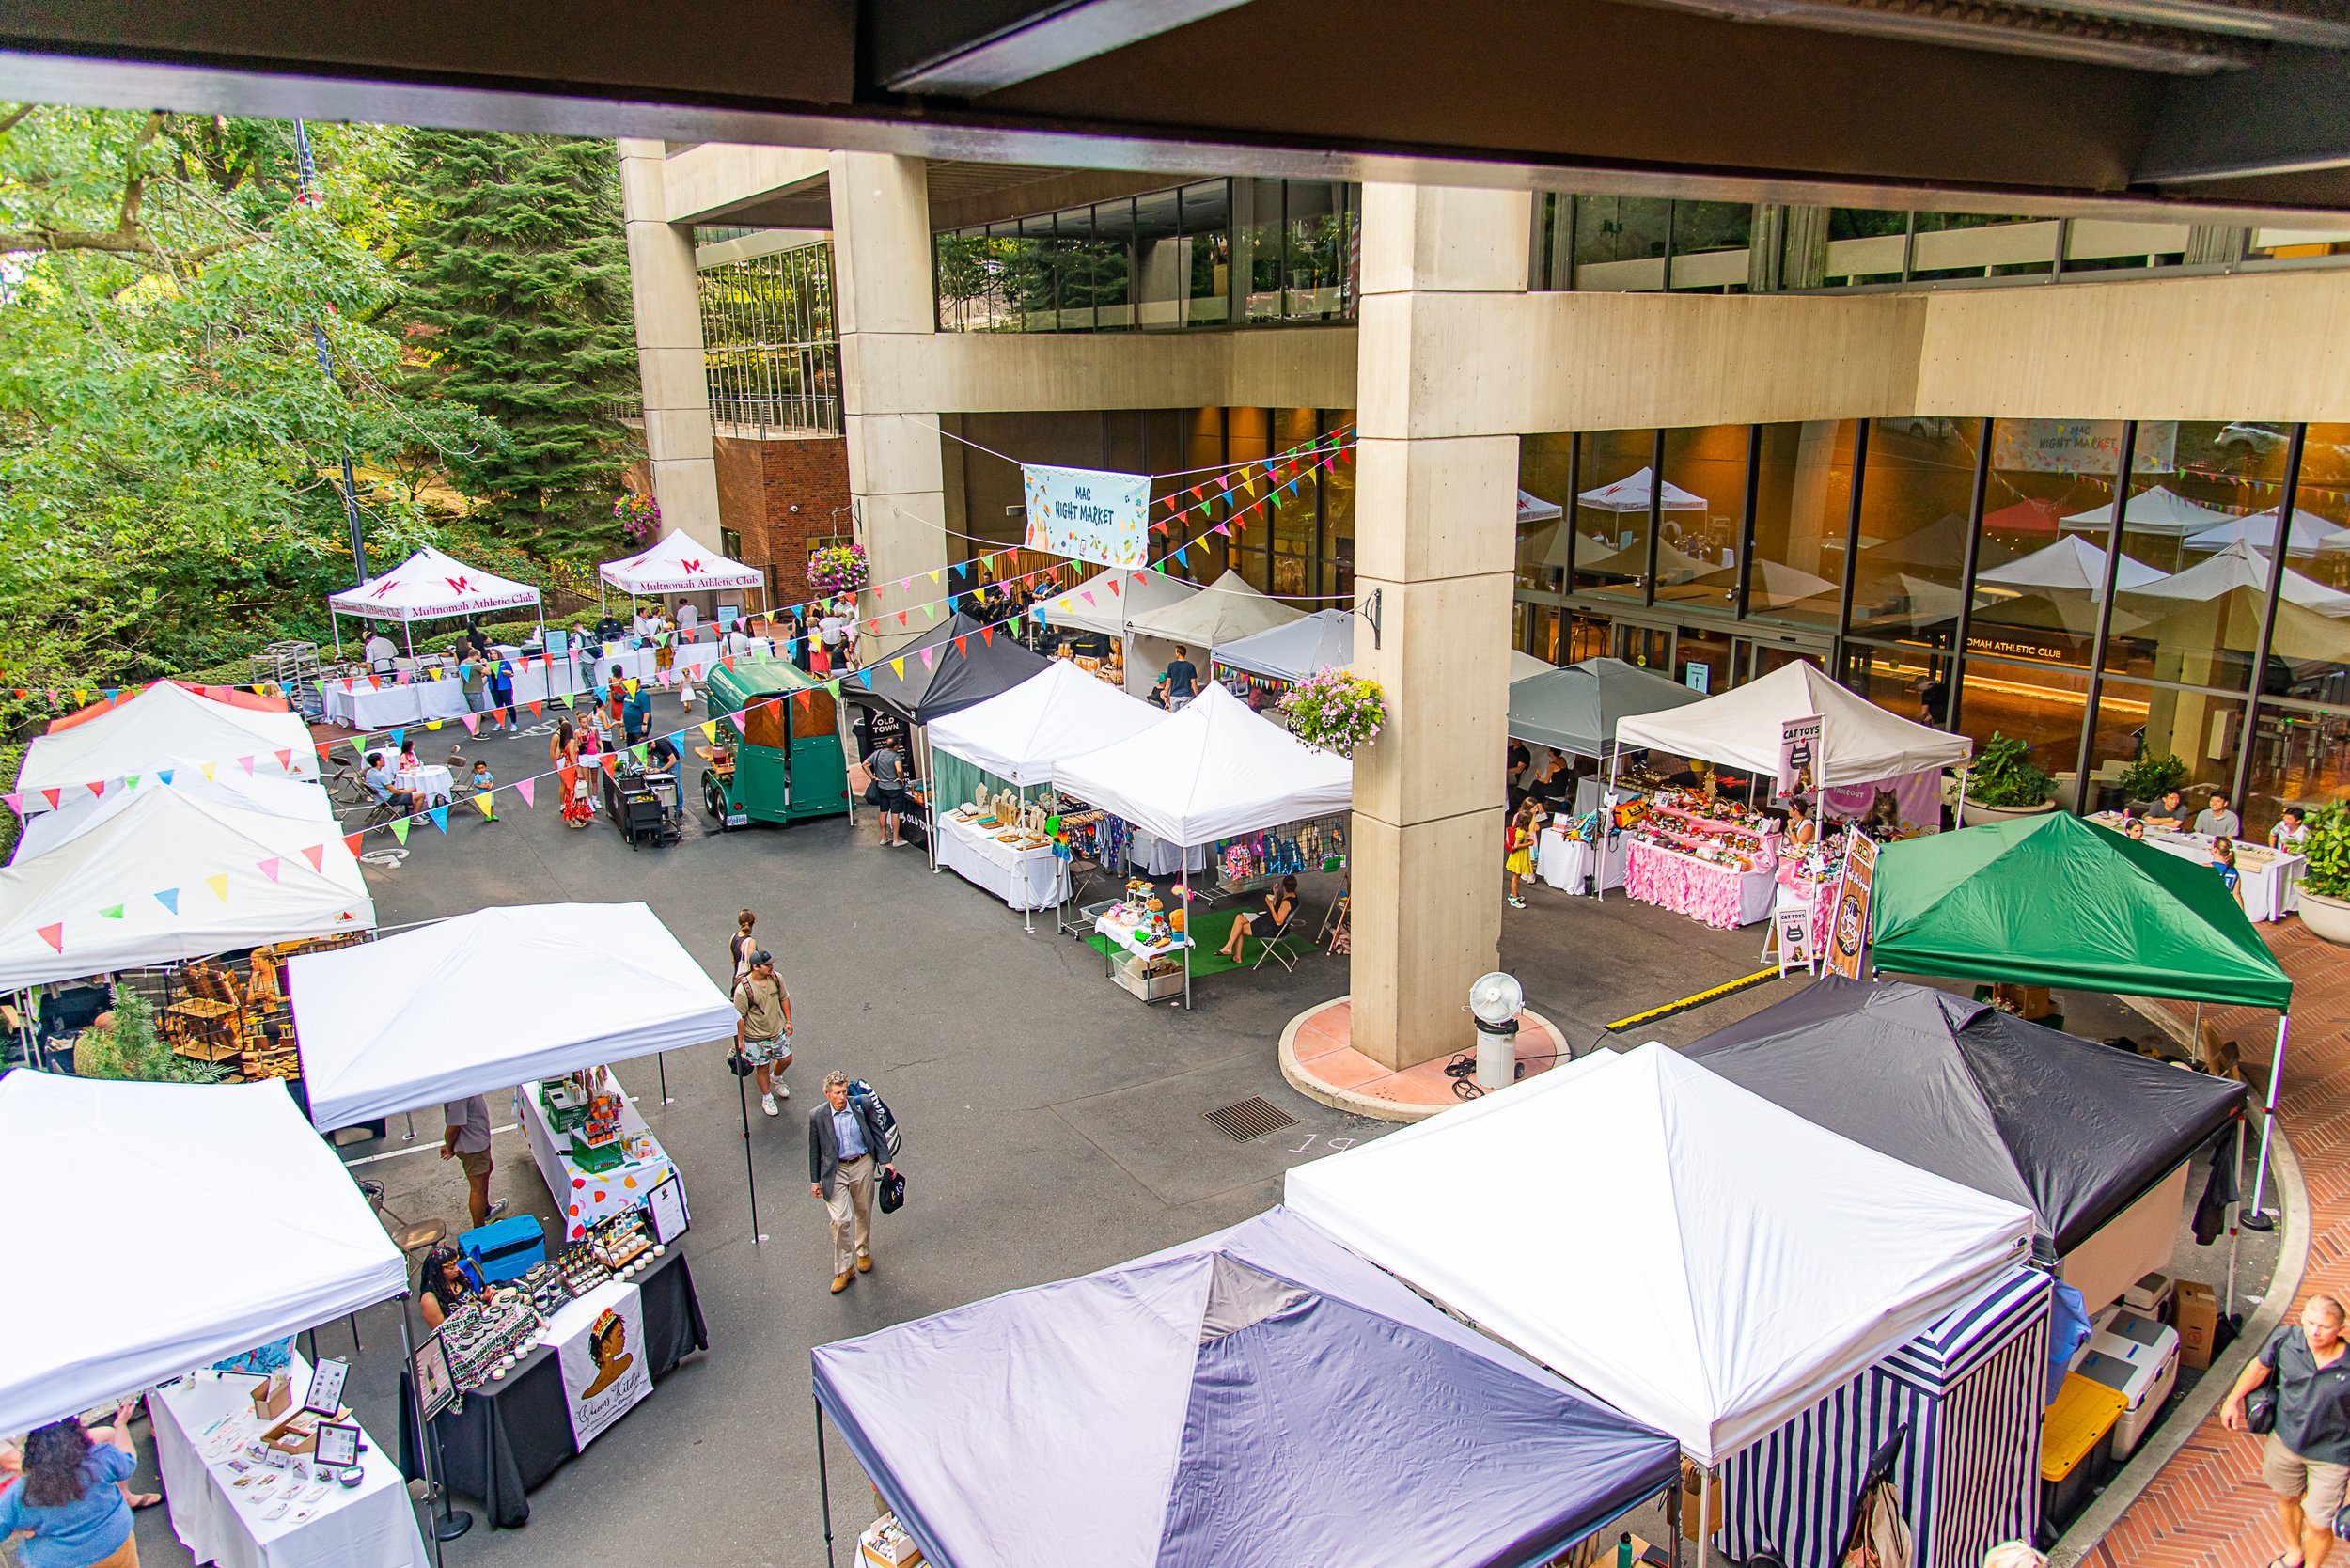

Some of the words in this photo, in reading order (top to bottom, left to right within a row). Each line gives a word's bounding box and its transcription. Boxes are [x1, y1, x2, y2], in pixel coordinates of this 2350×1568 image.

[2070, 425, 2092, 435] MAC
[2039, 437, 2071, 449] NIGHT
[1074, 486, 1091, 501] MAC
[1055, 500, 1079, 521] NIGHT
[1080, 505, 1114, 526] MARKET
[640, 579, 695, 592] Multnomah
[697, 577, 734, 588] Athletic
[735, 574, 760, 586] Club
[386, 605, 401, 619] Club
[412, 601, 469, 618] Multnomah
[472, 596, 509, 611] Athletic
[511, 592, 535, 604] Club
[1994, 641, 2036, 655] ATHLETIC
[2037, 648, 2061, 658] CLUB
[873, 723, 900, 733] TOWN
[877, 717, 895, 726] OLD
[1783, 729, 1799, 739] CAT
[1799, 725, 1820, 737] TOYS
[1833, 787, 1865, 799] TAKEOUT
[907, 813, 918, 826] OLD
